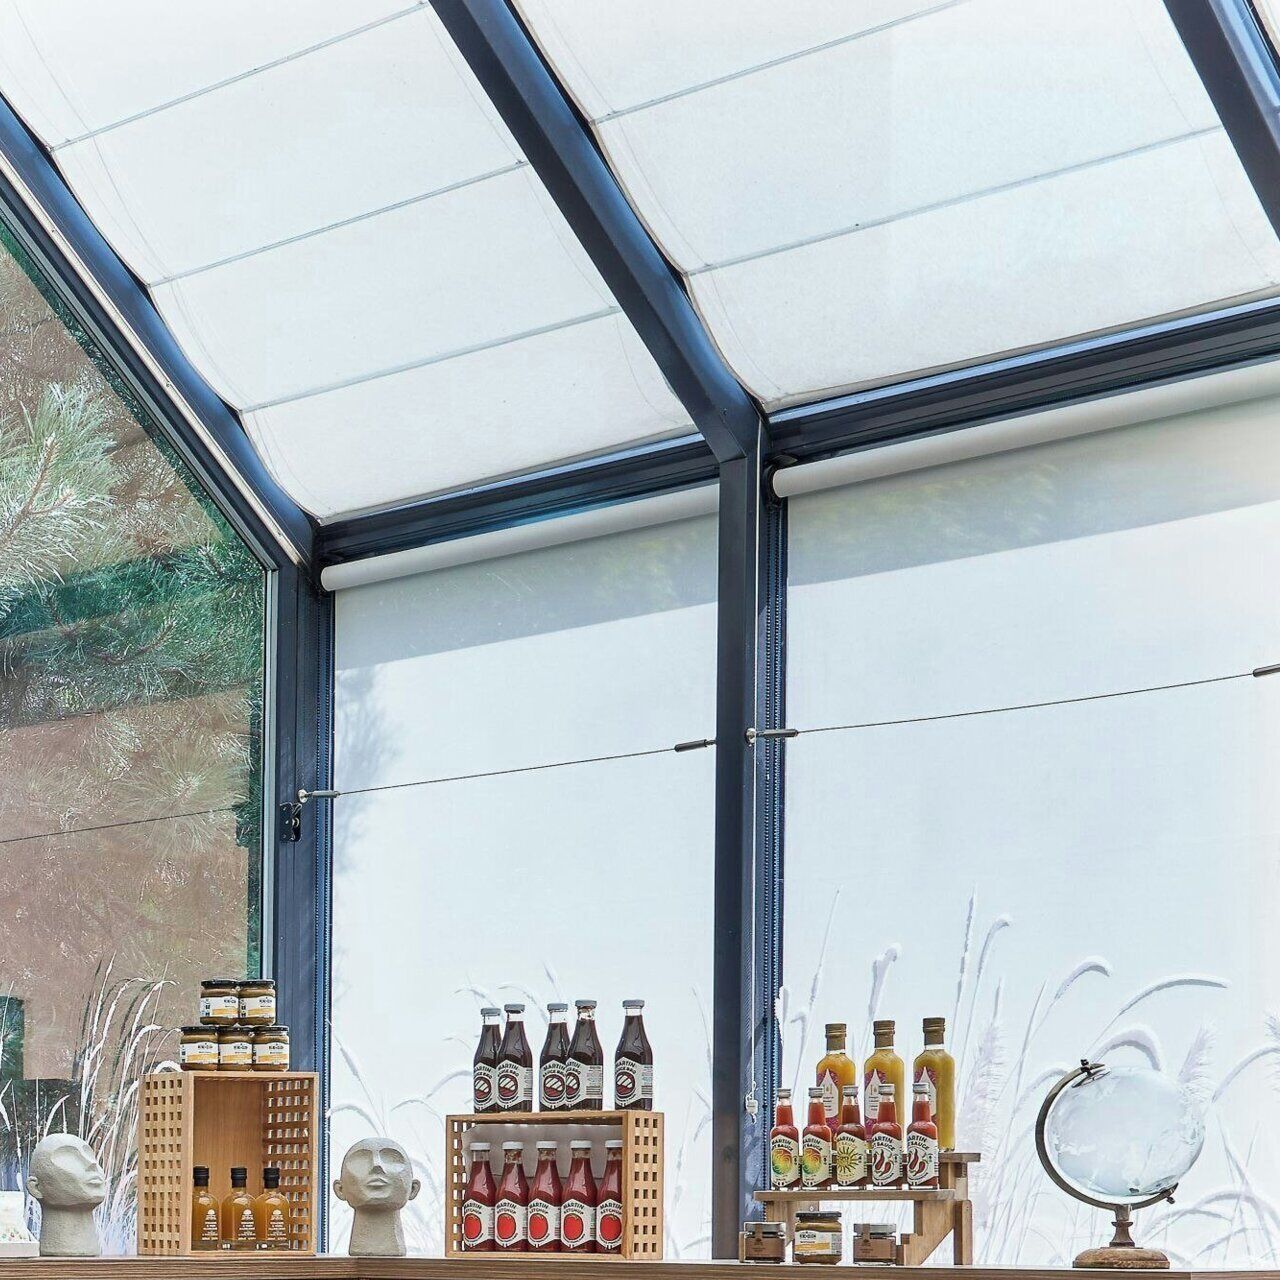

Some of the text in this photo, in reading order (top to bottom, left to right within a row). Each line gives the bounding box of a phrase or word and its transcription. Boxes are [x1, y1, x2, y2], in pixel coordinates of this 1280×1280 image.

[498, 1063, 519, 1071] MARTIN
[543, 1063, 566, 1071] MARTIN
[616, 1061, 636, 1069] MARTIN
[464, 1202, 483, 1211] MARTIN
[496, 1202, 517, 1210] MARTIN
[529, 1202, 549, 1211] MARTIN
[563, 1202, 585, 1210] MARTIN
[600, 1202, 623, 1210] MARTIN
